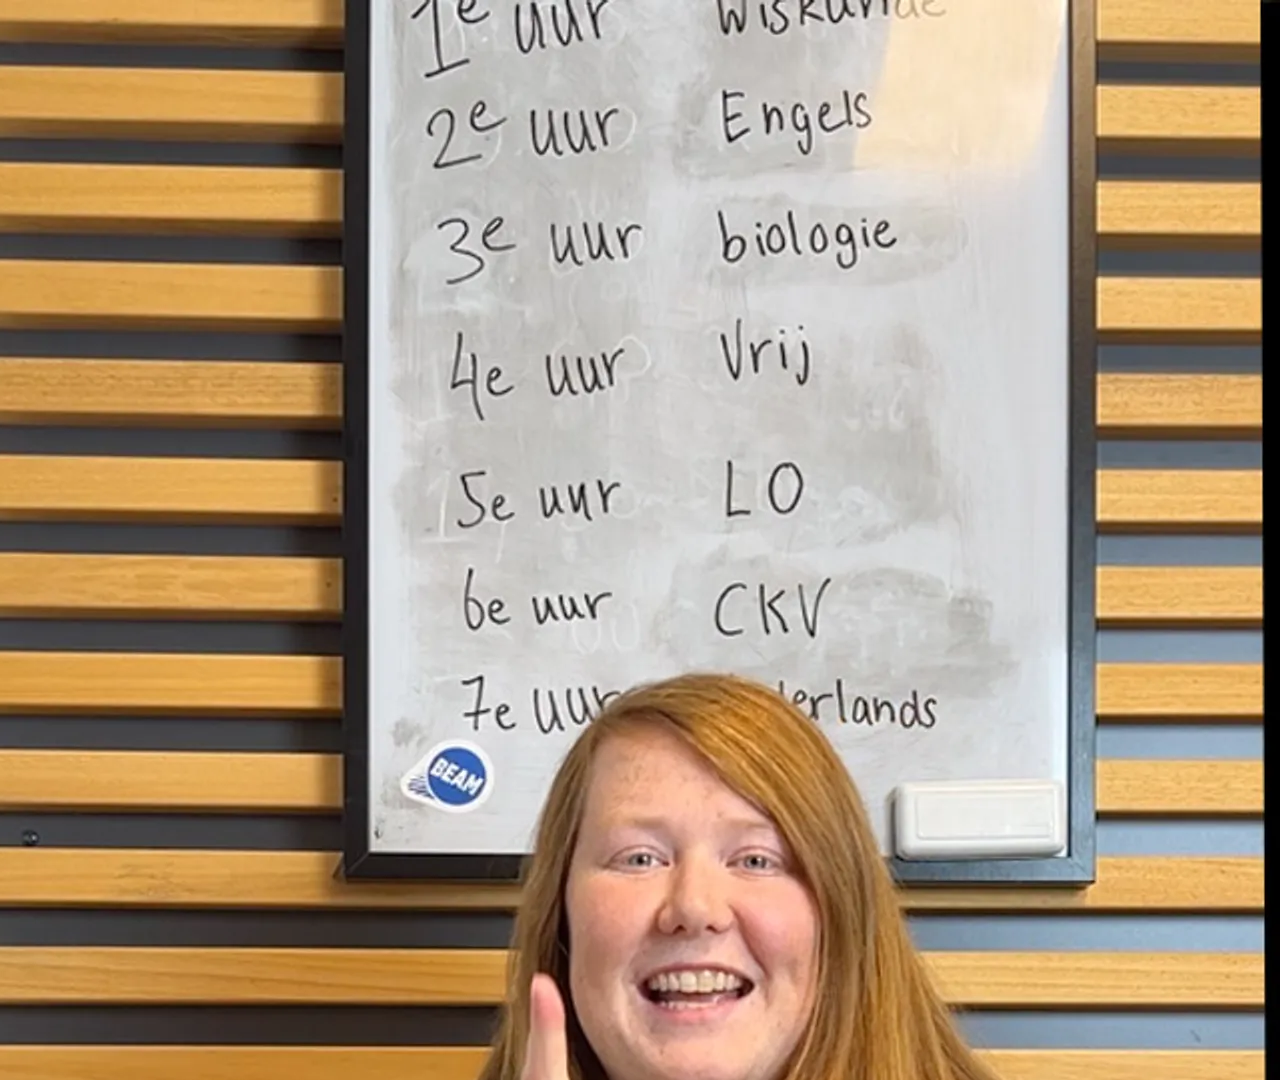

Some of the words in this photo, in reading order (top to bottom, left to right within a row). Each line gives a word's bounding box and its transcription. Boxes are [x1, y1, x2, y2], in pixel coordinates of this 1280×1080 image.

[513, 0, 609, 55] uur
[425, 99, 508, 170] 2e
[529, 107, 620, 157] uur
[721, 89, 873, 157] Engels
[436, 216, 517, 286] 3e
[549, 221, 643, 267] uur
[717, 209, 898, 270] biologie
[449, 331, 515, 422] 4e
[545, 347, 626, 397] uur
[719, 317, 810, 387] Vrij
[456, 469, 516, 530] 5e
[538, 478, 622, 522] uur
[725, 459, 805, 518] LO
[463, 567, 512, 632] 6e
[532, 591, 613, 626] uur
[713, 577, 832, 640] CKV
[460, 674, 518, 732] 7e
[778, 679, 937, 729] erlands
[429, 757, 484, 796] BEAM
